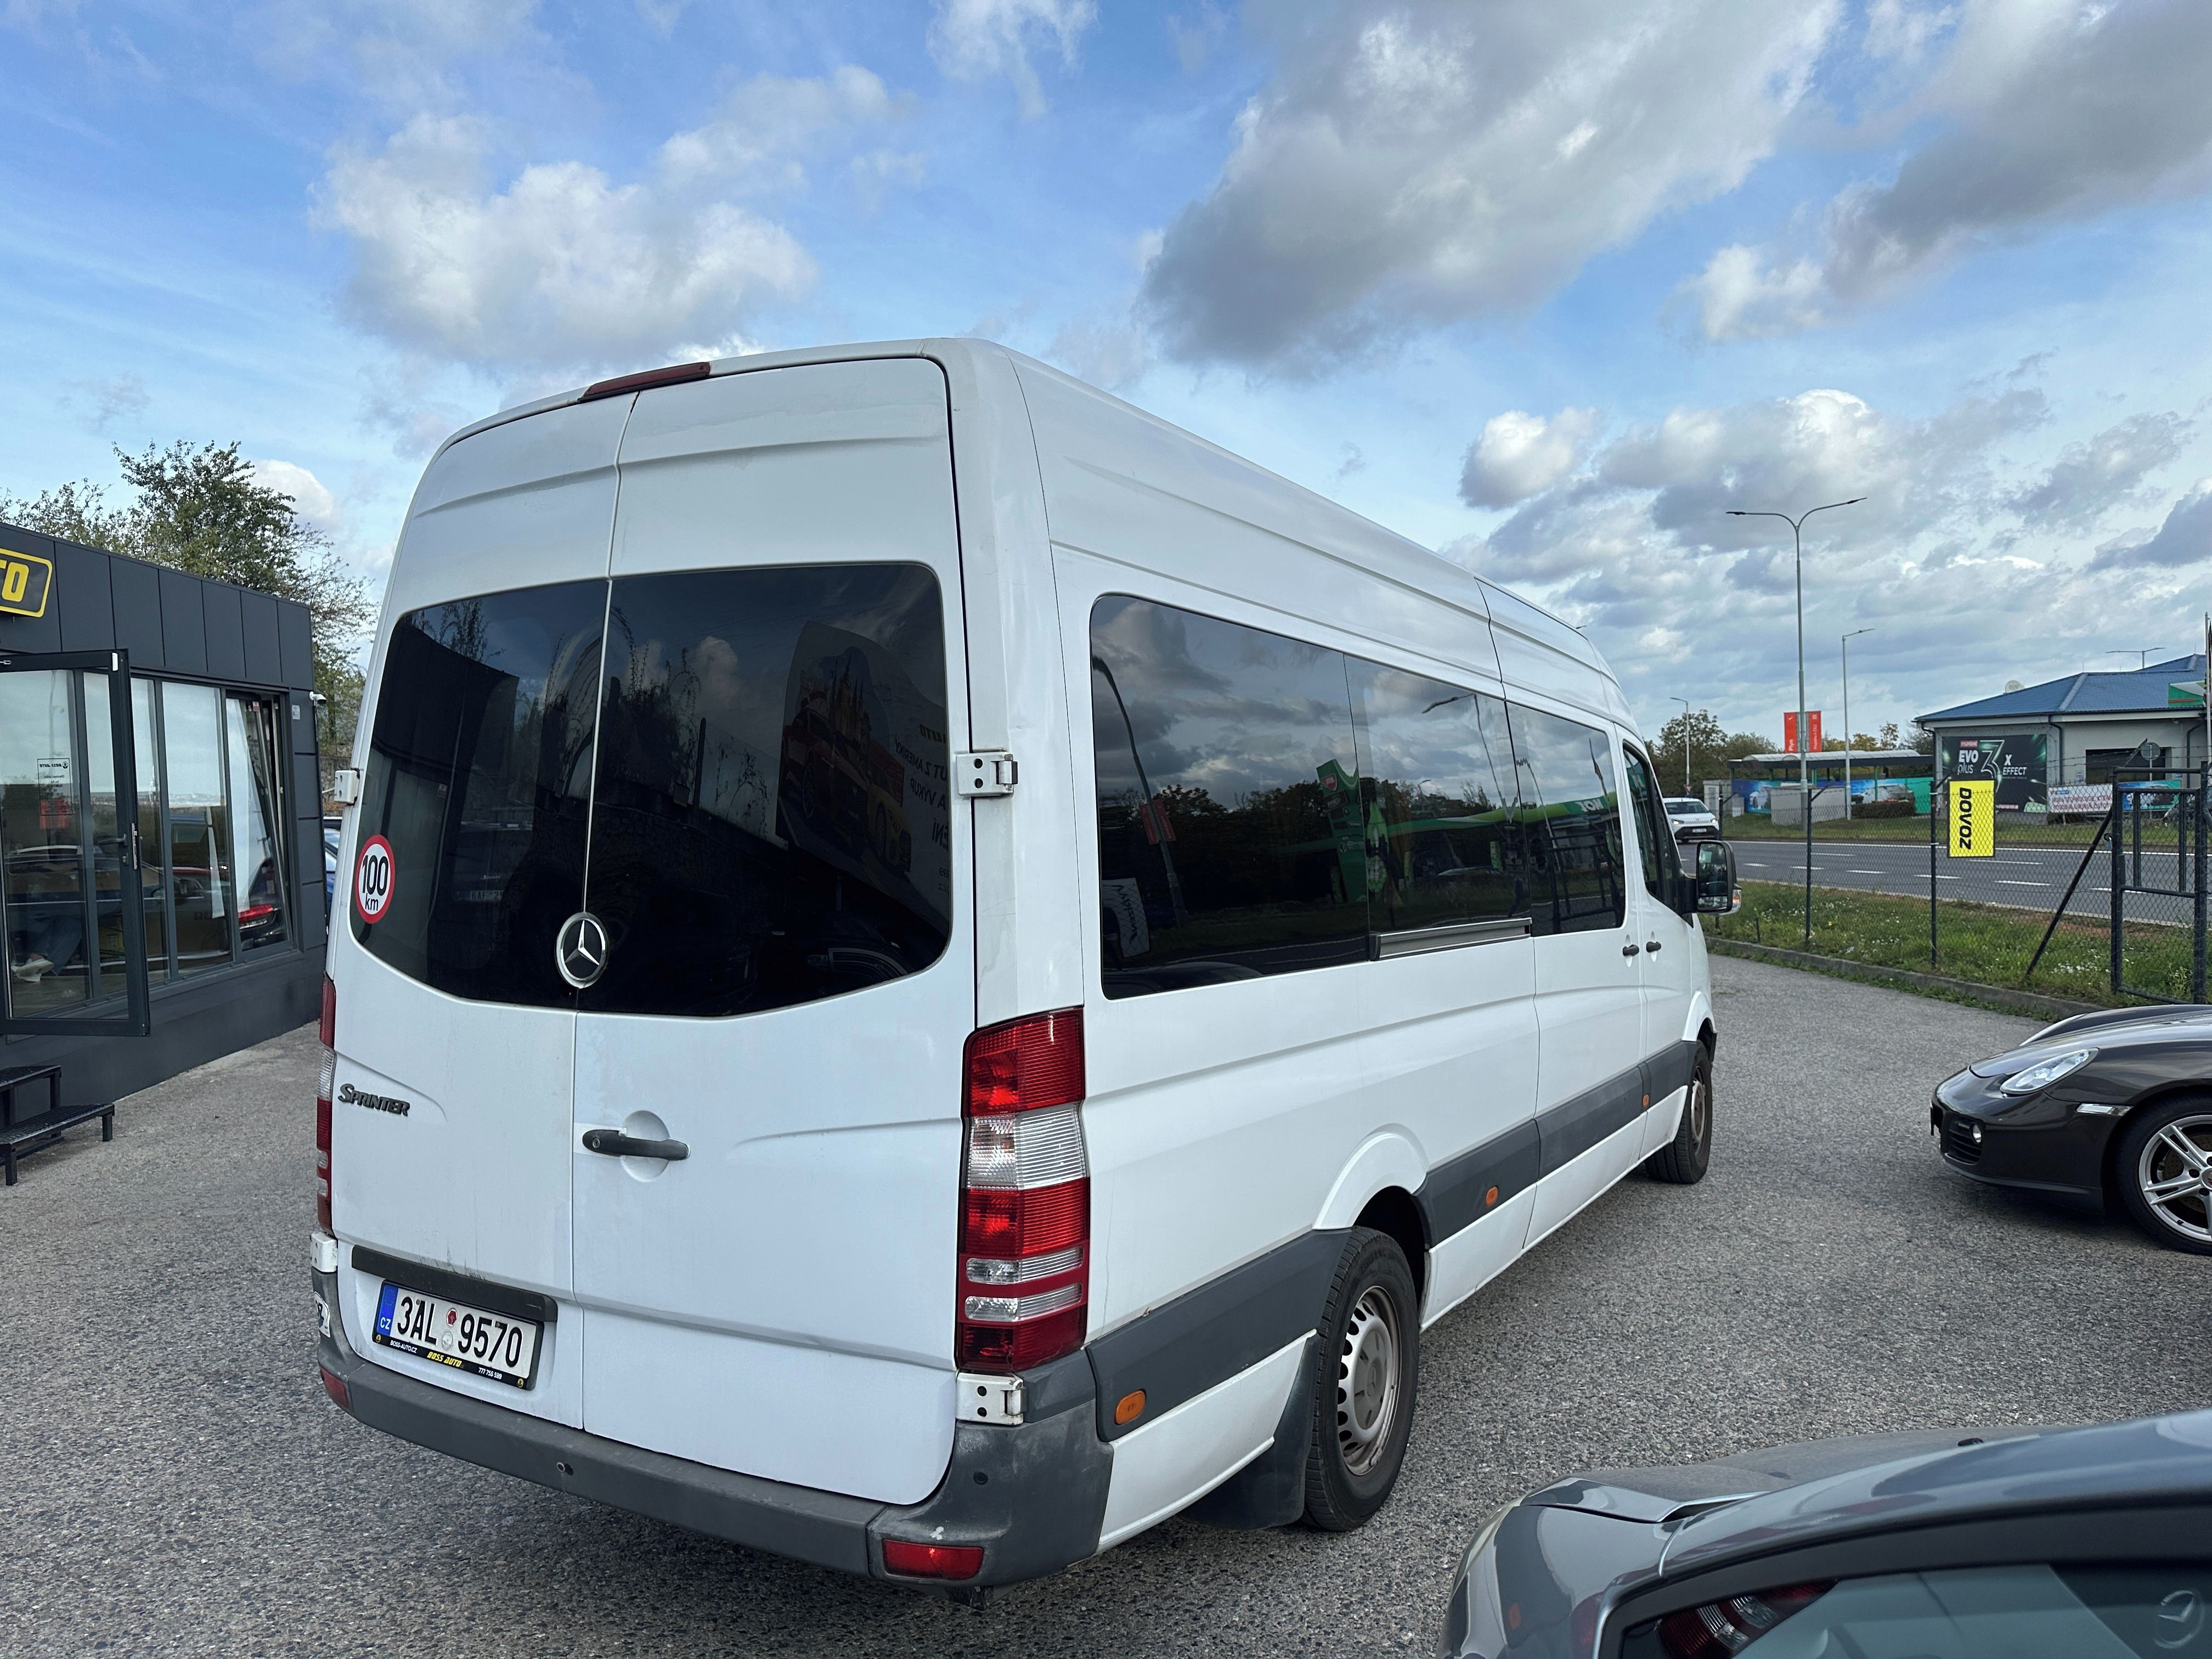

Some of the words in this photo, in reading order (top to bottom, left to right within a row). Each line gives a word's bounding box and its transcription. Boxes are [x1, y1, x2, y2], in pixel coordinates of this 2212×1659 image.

[1959, 749, 1979, 763] EVO
[2004, 754, 2012, 766] X
[1957, 761, 1974, 775] plus
[2002, 766, 2027, 776] EFFECT
[1960, 787, 1972, 850] DOVOZ
[362, 855, 389, 896] 100
[365, 893, 379, 911] km
[338, 1083, 410, 1116] SPRINTER
[380, 1316, 391, 1330] CZ
[397, 1296, 437, 1345] 3AL
[458, 1313, 523, 1368] 9570
[426, 1351, 444, 1362] BOSS
[443, 1357, 462, 1367] AUTO
